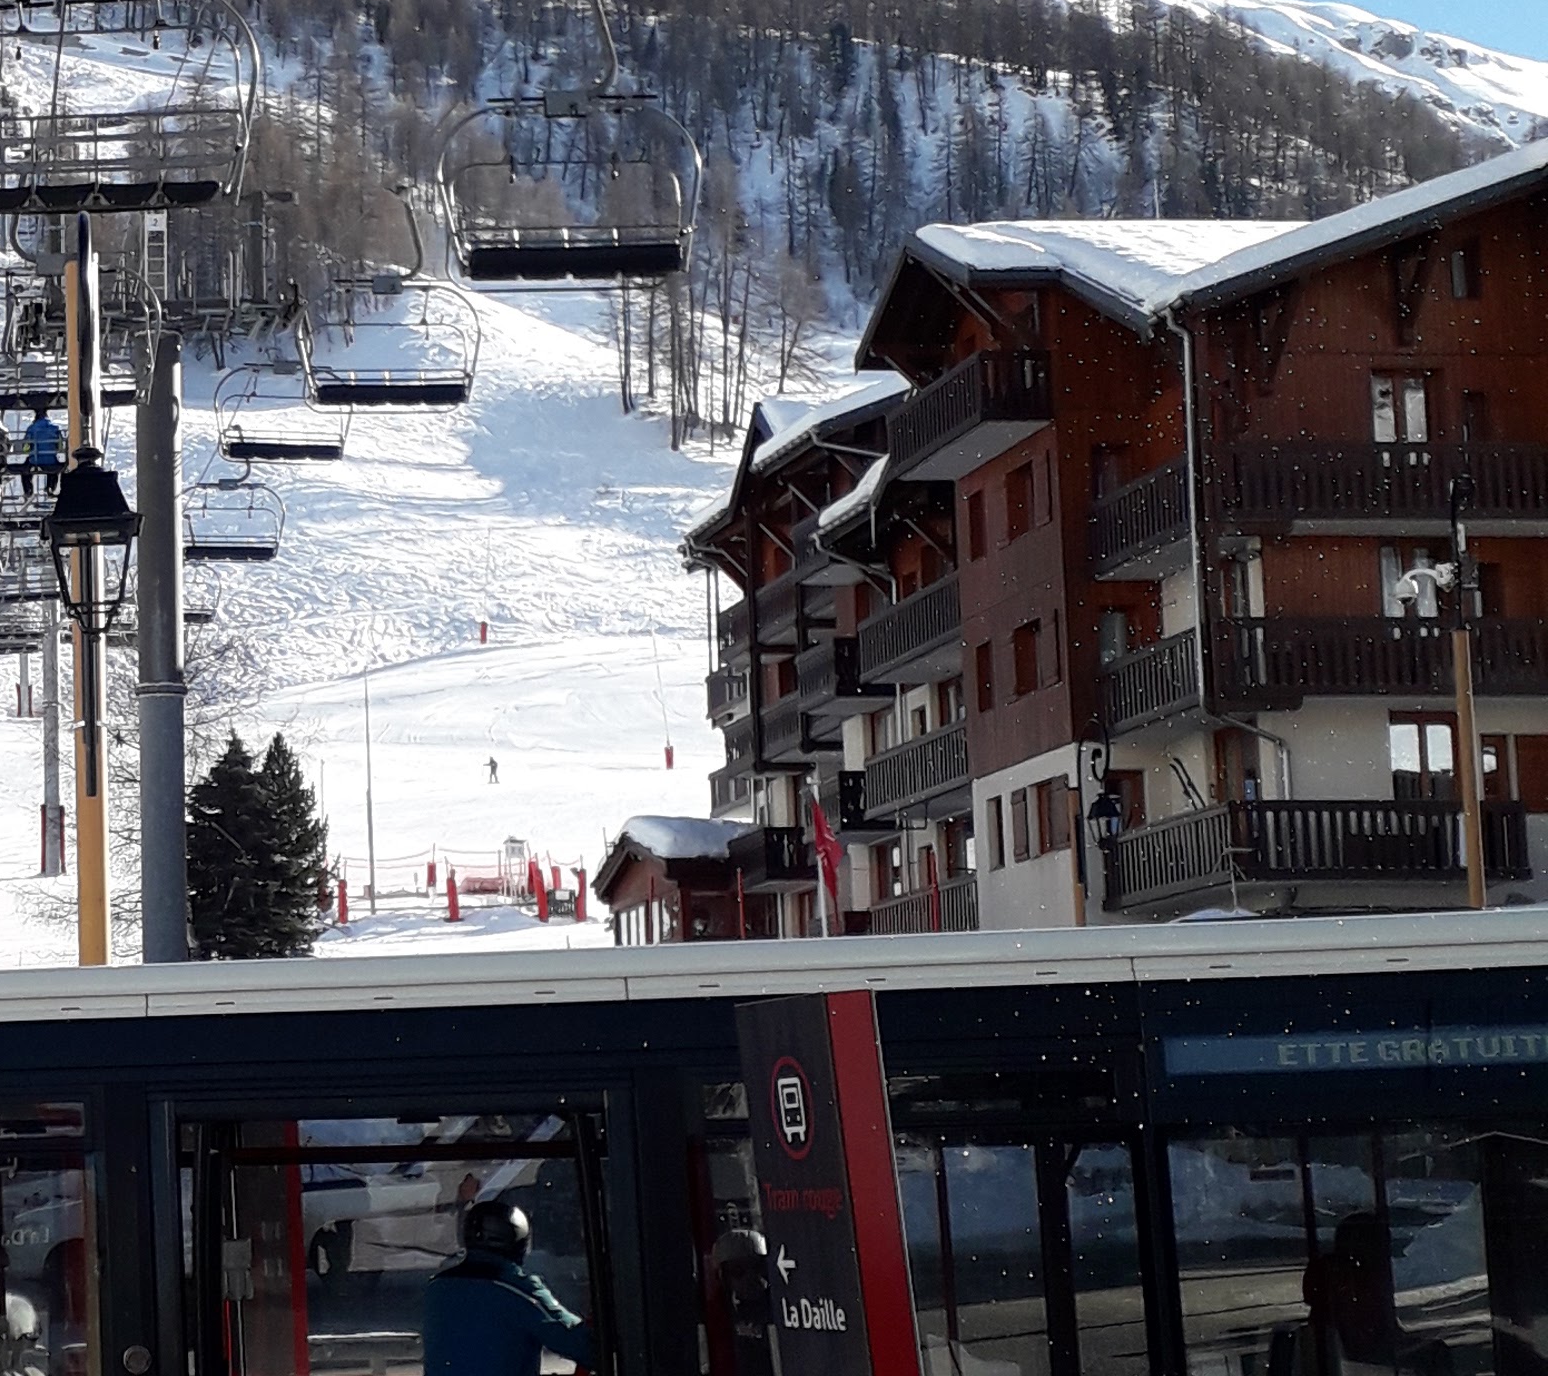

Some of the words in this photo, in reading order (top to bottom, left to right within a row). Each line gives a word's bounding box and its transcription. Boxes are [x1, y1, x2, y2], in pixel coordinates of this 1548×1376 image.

[1378, 1034, 1548, 1064] GRATUIT
[762, 1183, 799, 1211] Train
[781, 1297, 800, 1328] La
[800, 1297, 848, 1332] Daille
